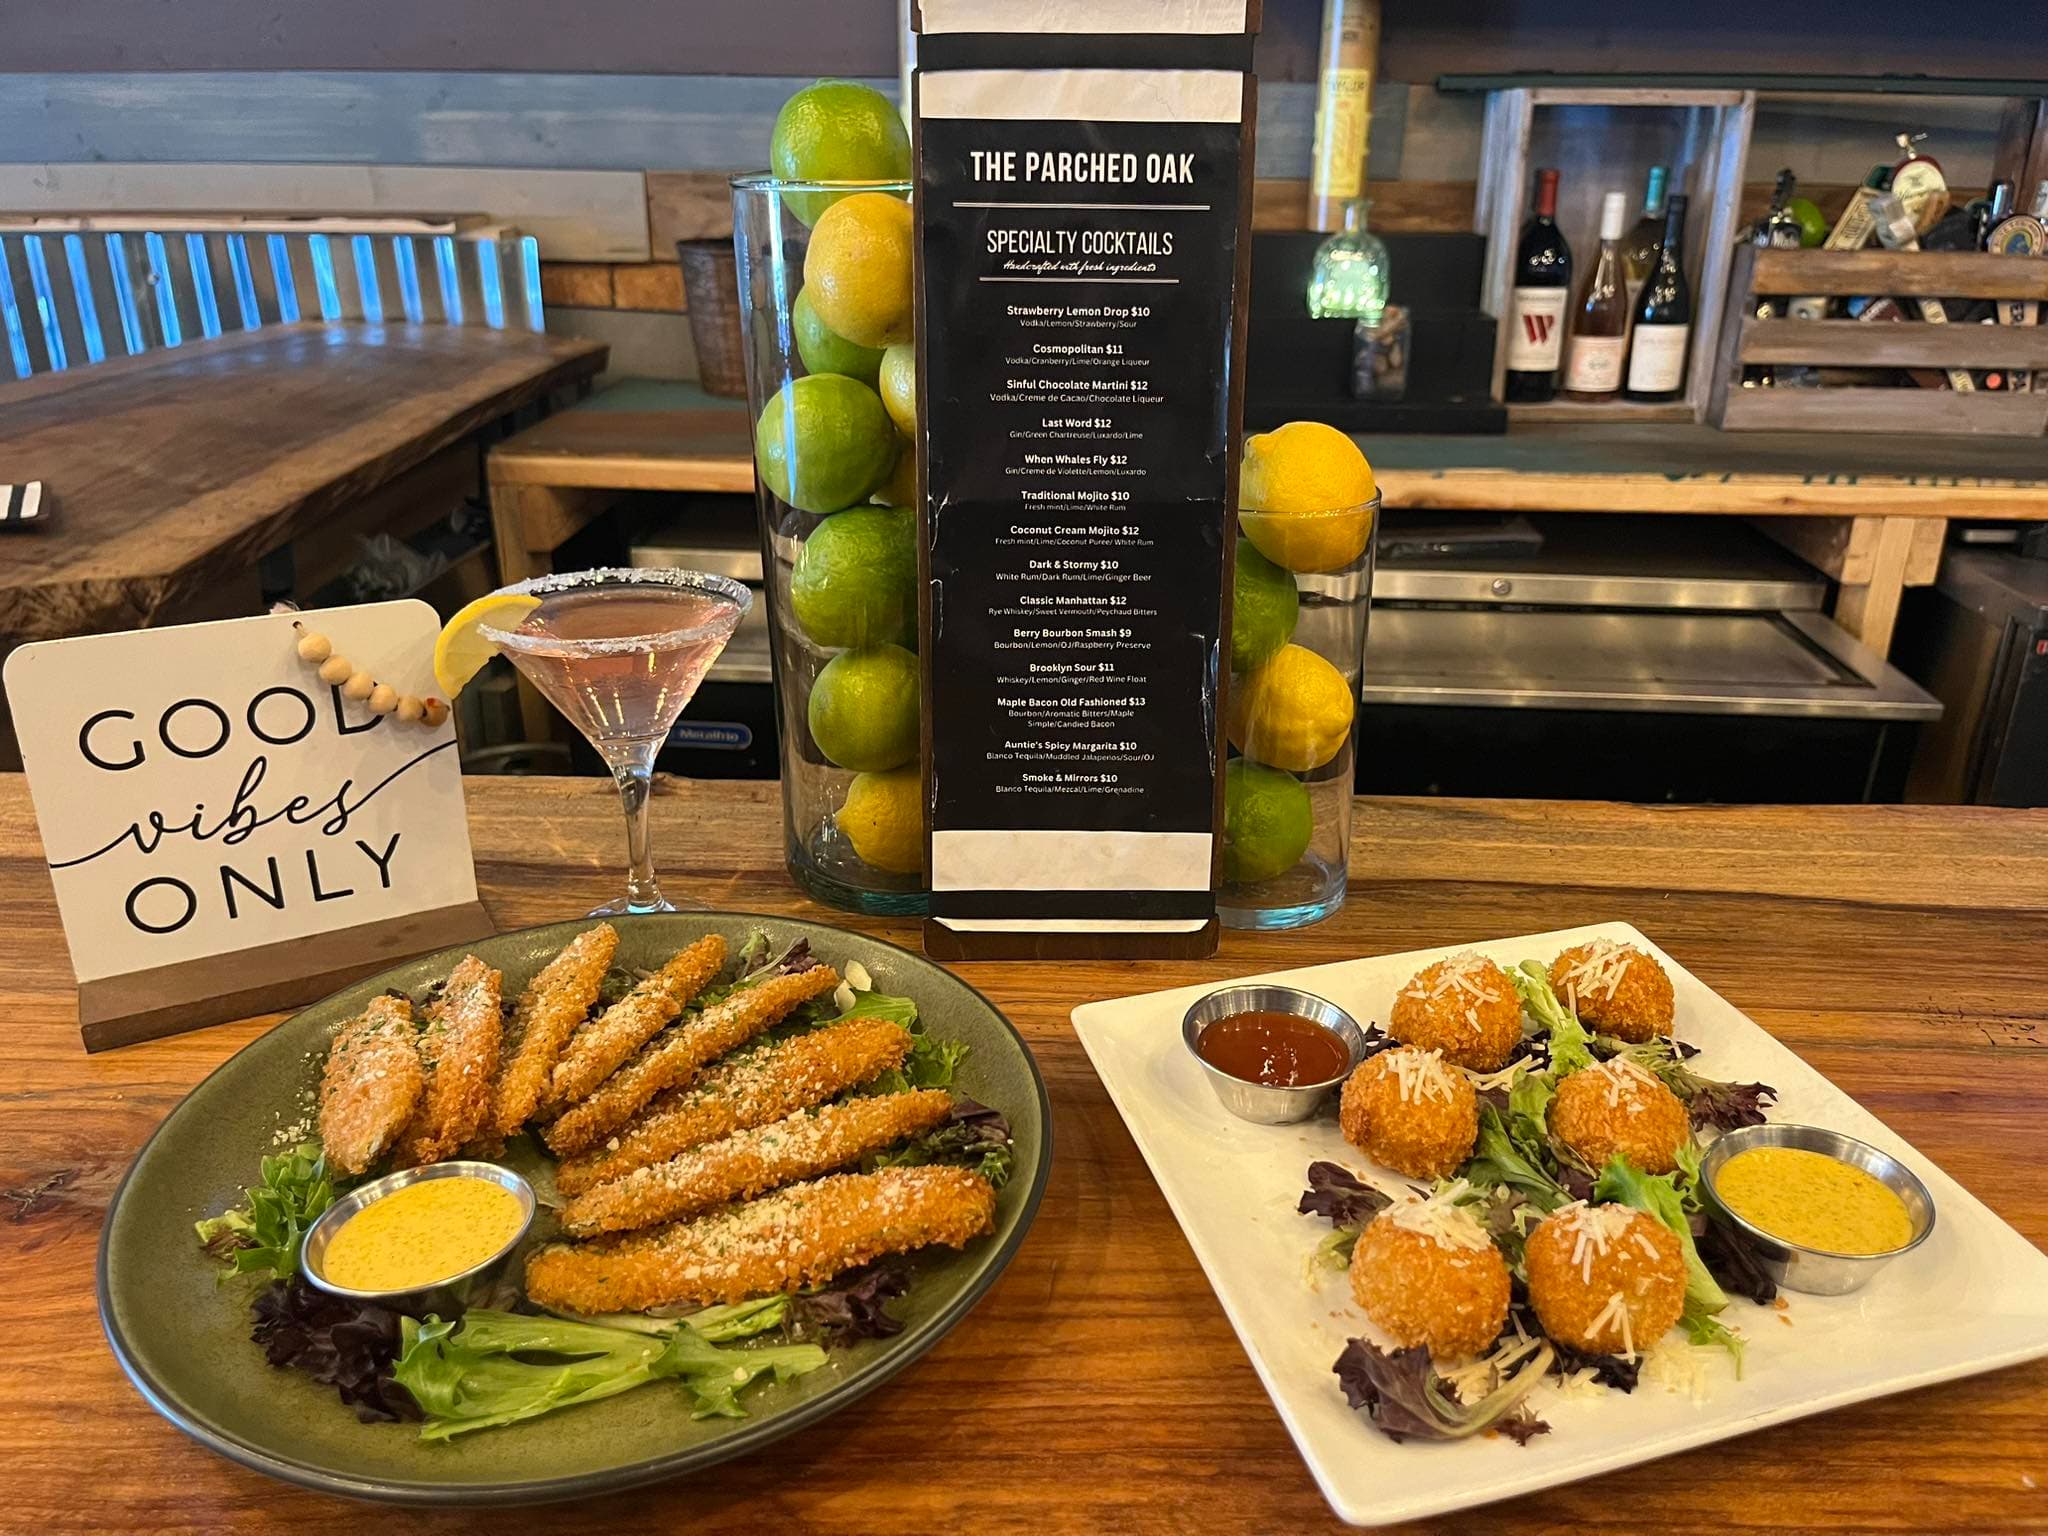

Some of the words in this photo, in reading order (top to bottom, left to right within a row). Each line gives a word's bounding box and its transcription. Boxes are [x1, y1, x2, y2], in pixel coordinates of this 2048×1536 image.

[970, 151, 1016, 181] THE
[1026, 152, 1137, 183] PARCHED
[1146, 153, 1195, 183] OAK
[987, 230, 1077, 254] SPECIALTY
[1082, 231, 1173, 255] COCKTAILS
[1003, 259, 1059, 275] Handcrafted
[1060, 260, 1080, 271] with
[1078, 260, 1104, 275] fresh
[1105, 261, 1156, 275] ingredients
[1007, 305, 1064, 318] Strawberry
[1066, 306, 1101, 316] Lemon
[1104, 306, 1129, 319] Drop
[1131, 306, 1150, 317] $10
[1020, 319, 1137, 329] Vodka/Lemon/Strawberry/Sour
[1033, 344, 1104, 356] Cosmopolitan
[1106, 344, 1123, 355] $11
[1005, 357, 1120, 367] Vodka/Cranberry/Lime/Orange
[1121, 358, 1150, 366] Liqueur
[1007, 379, 1036, 389] Sinful
[1038, 380, 1090, 390] Chocolate
[1092, 380, 1128, 390] Martini
[1130, 380, 1148, 391] $12
[1047, 394, 1059, 402] de
[1060, 394, 1131, 403] Cacao/Chocolate
[1132, 395, 1164, 404] Liqueur
[1042, 418, 1063, 427] Last
[1065, 418, 1092, 428] Word
[1094, 418, 1112, 428] $12
[1009, 430, 1048, 438] Gin/Green
[1049, 431, 1143, 439] Chartreuse/Luxardo/Lime
[1025, 454, 1053, 464] When
[1055, 454, 1091, 464] Whales
[1093, 455, 1108, 467] Fly
[1110, 454, 1127, 465] $12
[1057, 466, 1147, 475] Violette/Lemon/Luxardo
[1021, 490, 1075, 500] Traditional
[1077, 491, 1109, 502] Mojito
[1111, 491, 1130, 501] $10
[1010, 525, 1052, 534] Coconut
[1054, 526, 1086, 534] Cream
[1088, 526, 1120, 537] Mojito
[1122, 526, 1139, 535] $12
[1029, 560, 1052, 569] Dark
[1054, 560, 1061, 569] &
[1063, 560, 1099, 571] Stormy
[1100, 560, 1119, 570] $10
[995, 573, 1019, 581] White
[1021, 573, 1060, 581] Rum/Dark
[1062, 573, 1131, 583] Rum/Lime/Ginger
[1133, 573, 1151, 581] Beer
[1020, 596, 1054, 605] Classic
[1056, 596, 1108, 605] Manhattan
[1110, 596, 1127, 605] $12
[988, 608, 1003, 616] Rye
[1003, 608, 1057, 616] Whiskey/Sweet
[1059, 608, 1132, 616] Vermouth/Peychaud
[1014, 629, 1040, 639] Berry
[1042, 628, 1083, 637] Bourbon
[1085, 628, 1117, 637] Smash
[1119, 628, 1132, 638] $9
[994, 641, 1114, 650] Bourbon/Lemon/OJ/Raspberry
[1116, 641, 1151, 649] Preserve
[1030, 663, 1072, 674] Brooklyn
[1074, 663, 1096, 672] Sour
[1098, 662, 1114, 672] $11
[997, 676, 1105, 685] Whiskey/Lemon/Ginger/Red
[1127, 675, 1146, 683] Float
[997, 698, 1026, 708] Maple
[1029, 698, 1058, 707] Bacon
[1060, 698, 1077, 707] Old
[1079, 697, 1127, 706] Fashioned
[1129, 697, 1146, 706] $13
[1008, 710, 1080, 718] Bourbon/Aromatic
[1082, 709, 1134, 718] Bitters/Maple
[1028, 720, 1089, 728] Simple/Candied
[1091, 720, 1115, 728] Bacon
[1005, 741, 1043, 749] Auntie's
[1045, 741, 1070, 752] Spicy
[1072, 742, 1118, 752] Margarita
[1119, 741, 1137, 751] $10
[1014, 752, 1080, 761] Tequila/Muddled
[1022, 773, 1054, 782] Smoke
[1055, 774, 1063, 782] &
[1064, 774, 1098, 782] Mirrors
[1100, 774, 1118, 783] $10
[996, 785, 1022, 793] Blanco
[1024, 785, 1144, 794] Tequila/Mezcal/Lime/Grenadine
[124, 832, 401, 934] ONLY
